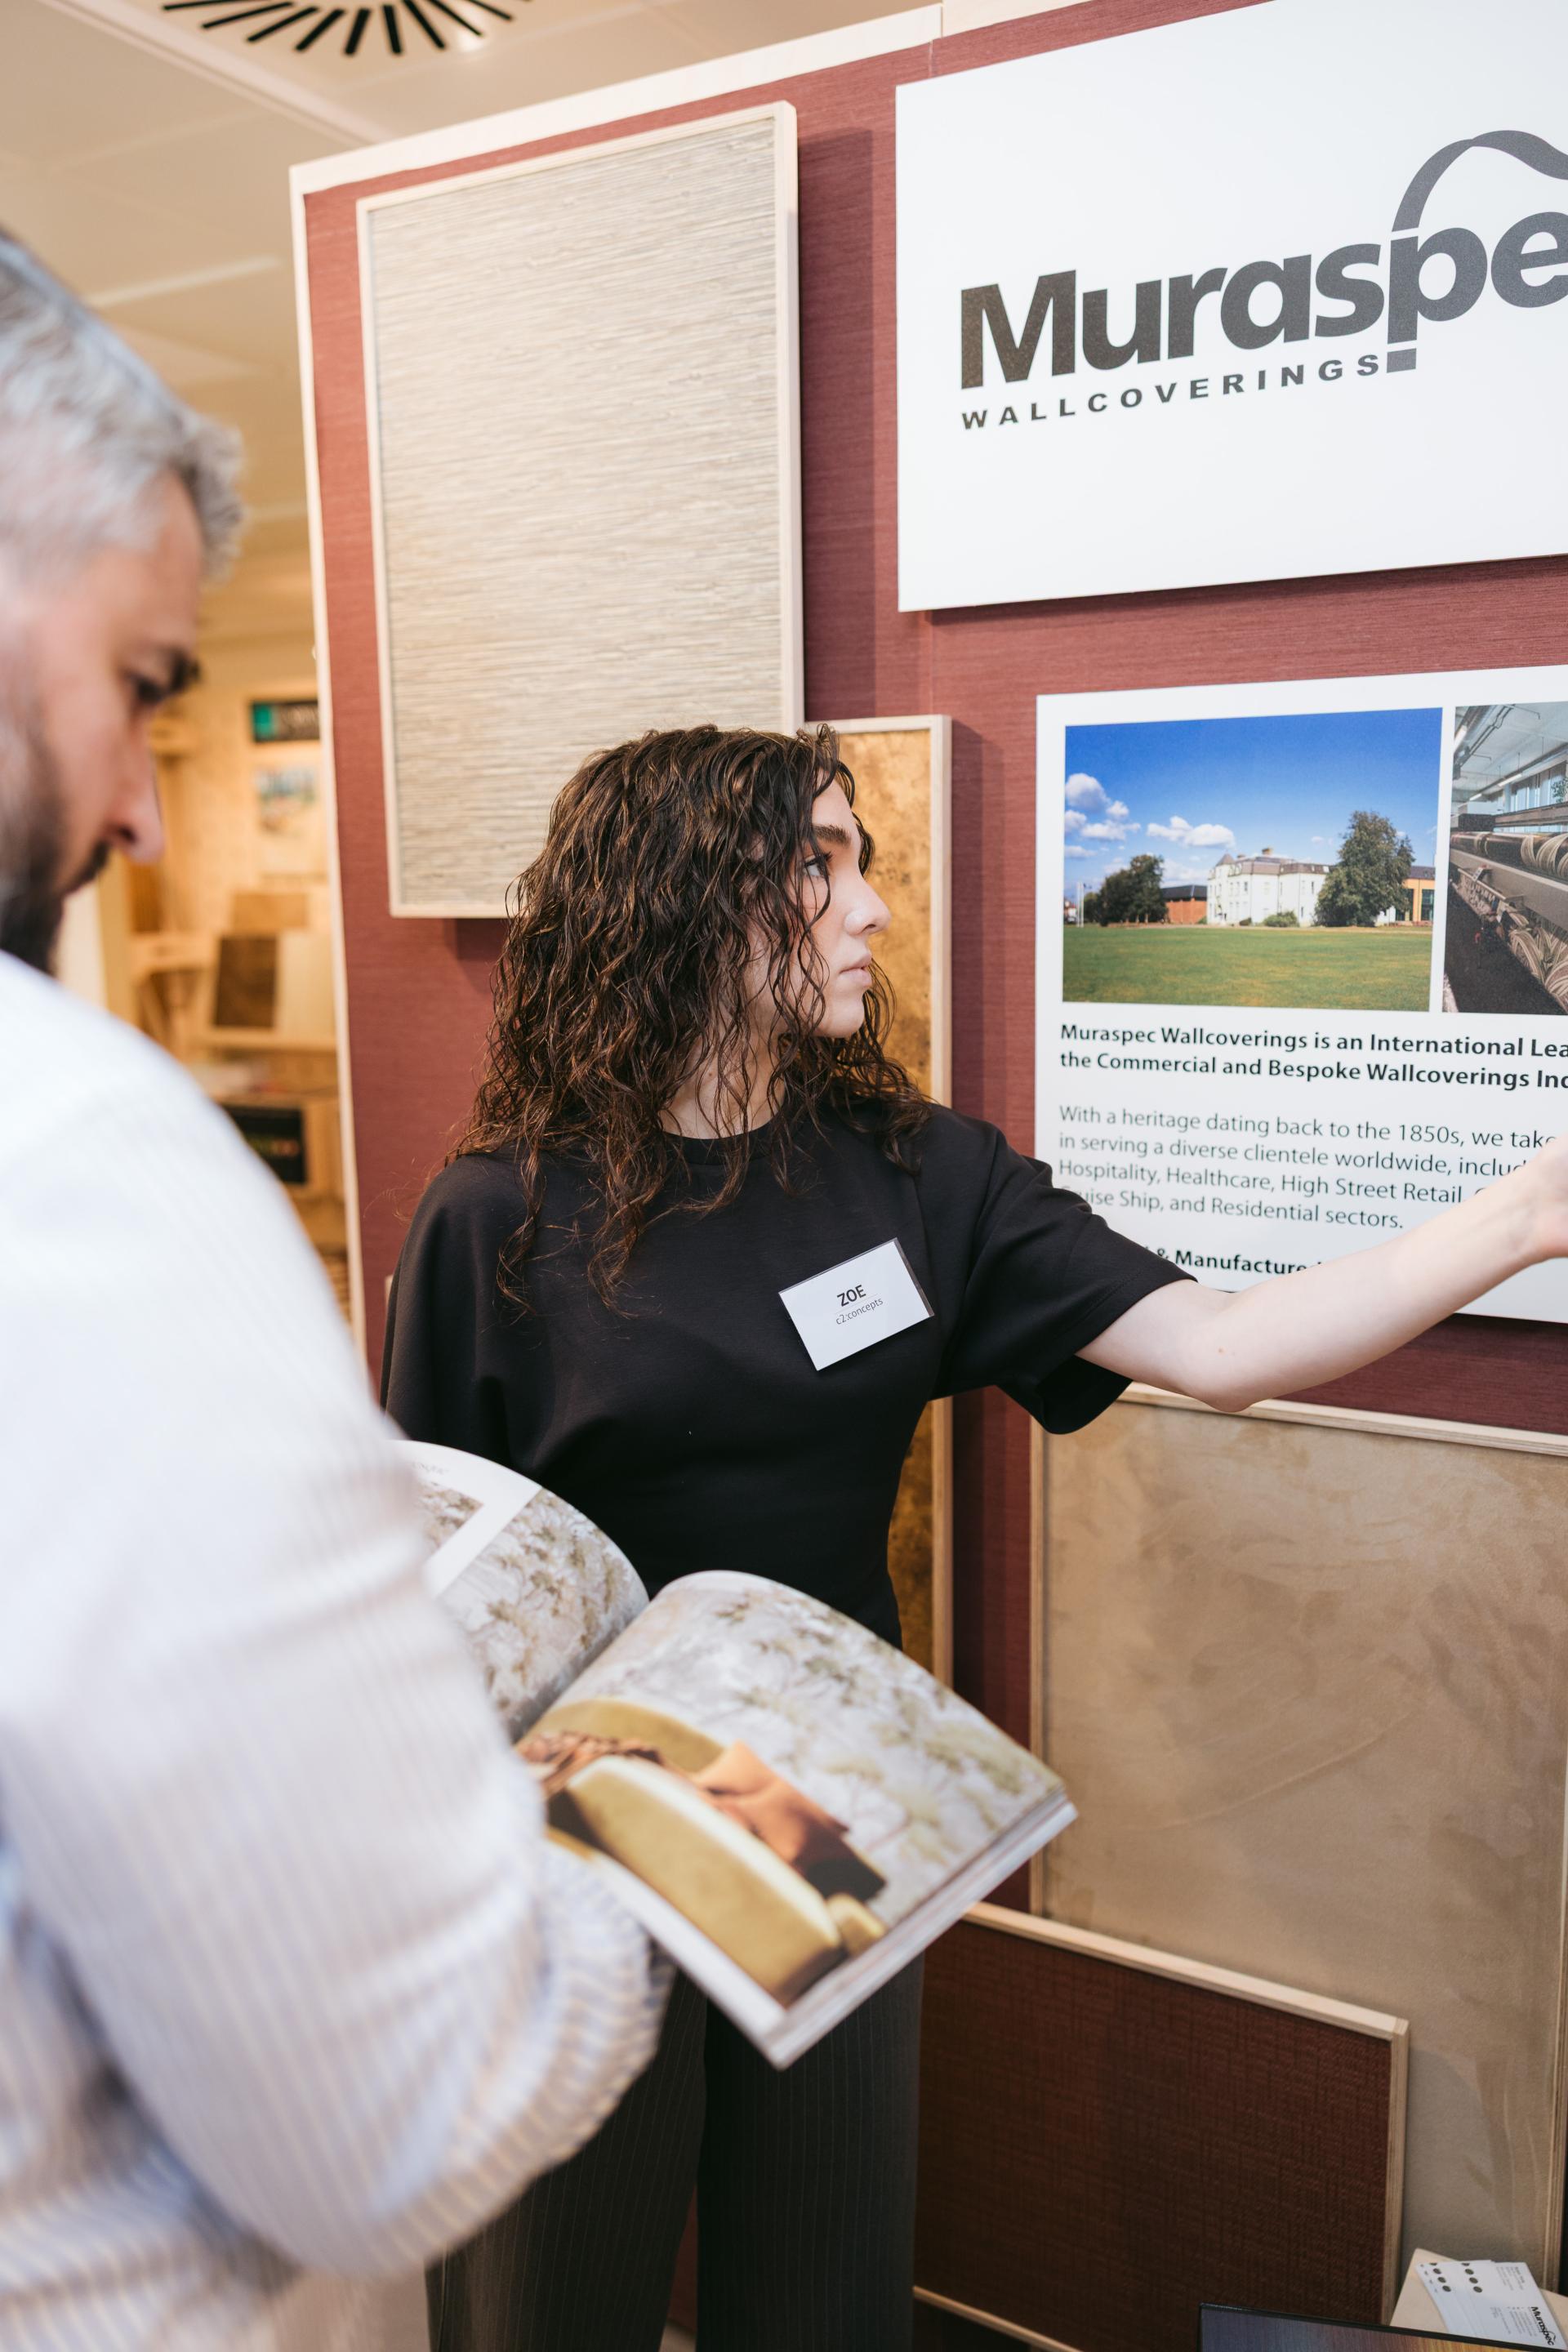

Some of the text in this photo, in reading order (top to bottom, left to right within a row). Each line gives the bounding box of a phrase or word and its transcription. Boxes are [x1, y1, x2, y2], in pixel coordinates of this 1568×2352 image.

[961, 212, 1568, 390] Muraspe
[961, 354, 1380, 430] WALLCOVERINGS
[1060, 1024, 1568, 1058] Muraspec Wallcoverings is an International Lea
[1060, 1051, 1091, 1068] the
[1097, 1052, 1216, 1074] Commercial
[1223, 1058, 1262, 1076] and
[1268, 1060, 1361, 1082] Bespoke
[1367, 1063, 1530, 1091] Wallcoverings
[1059, 1105, 1101, 1124] With
[1107, 1111, 1116, 1125] a
[1122, 1108, 1200, 1133] heritage
[1206, 1113, 1270, 1138] dating
[1276, 1116, 1323, 1136] back
[1330, 1122, 1350, 1138] to
[1356, 1121, 1391, 1141] the
[1399, 1124, 1465, 1147] 1850s,
[1472, 1132, 1503, 1147] we
[1059, 1132, 1076, 1149] in
[1080, 1135, 1147, 1157] serving
[1153, 1143, 1164, 1155] a
[1169, 1139, 1238, 1160] diverse
[1244, 1143, 1329, 1166] clientele
[1334, 1151, 1452, 1176] worldwide,
[1059, 1160, 1160, 1185] Hospitality,
[1166, 1167, 1275, 1193] Healthcare,
[1281, 1174, 1329, 1197] High
[1335, 1178, 1397, 1200] Street
[1119, 1190, 1164, 1213] Ship,
[1169, 1196, 1205, 1214] and
[1212, 1197, 1319, 1222] Residential
[1325, 1209, 1404, 1229] sectors.
[835, 1298, 884, 1325] c2:concepts
[836, 1285, 866, 1307] ZOE
